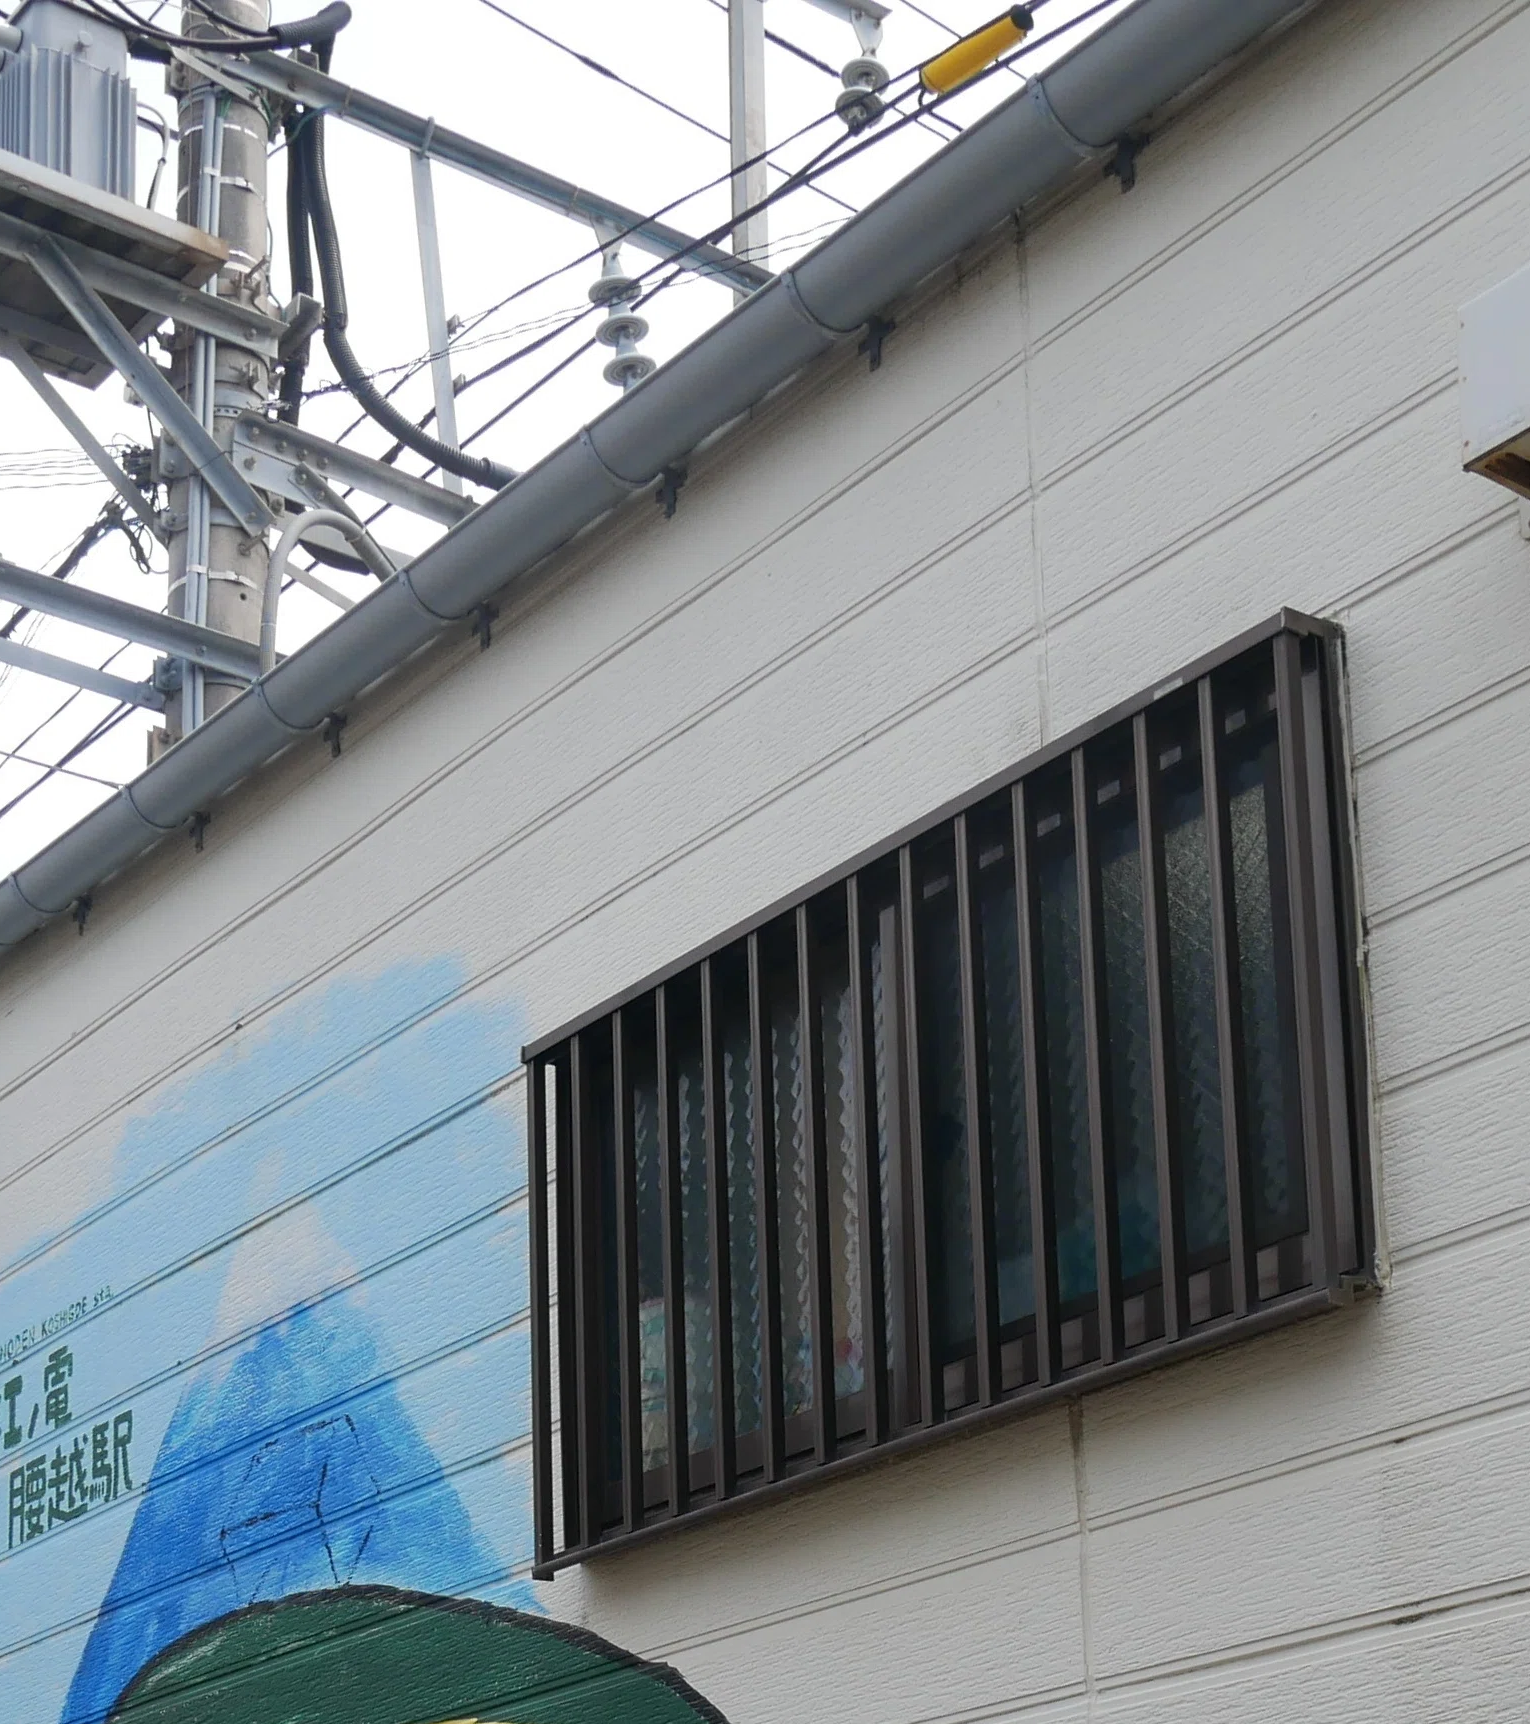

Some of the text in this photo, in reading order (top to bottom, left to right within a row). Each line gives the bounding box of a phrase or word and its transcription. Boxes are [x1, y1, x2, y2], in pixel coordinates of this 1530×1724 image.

[41, 1296, 87, 1338] KOSHIGOE
[8, 1410, 133, 1550] 腰越駅
